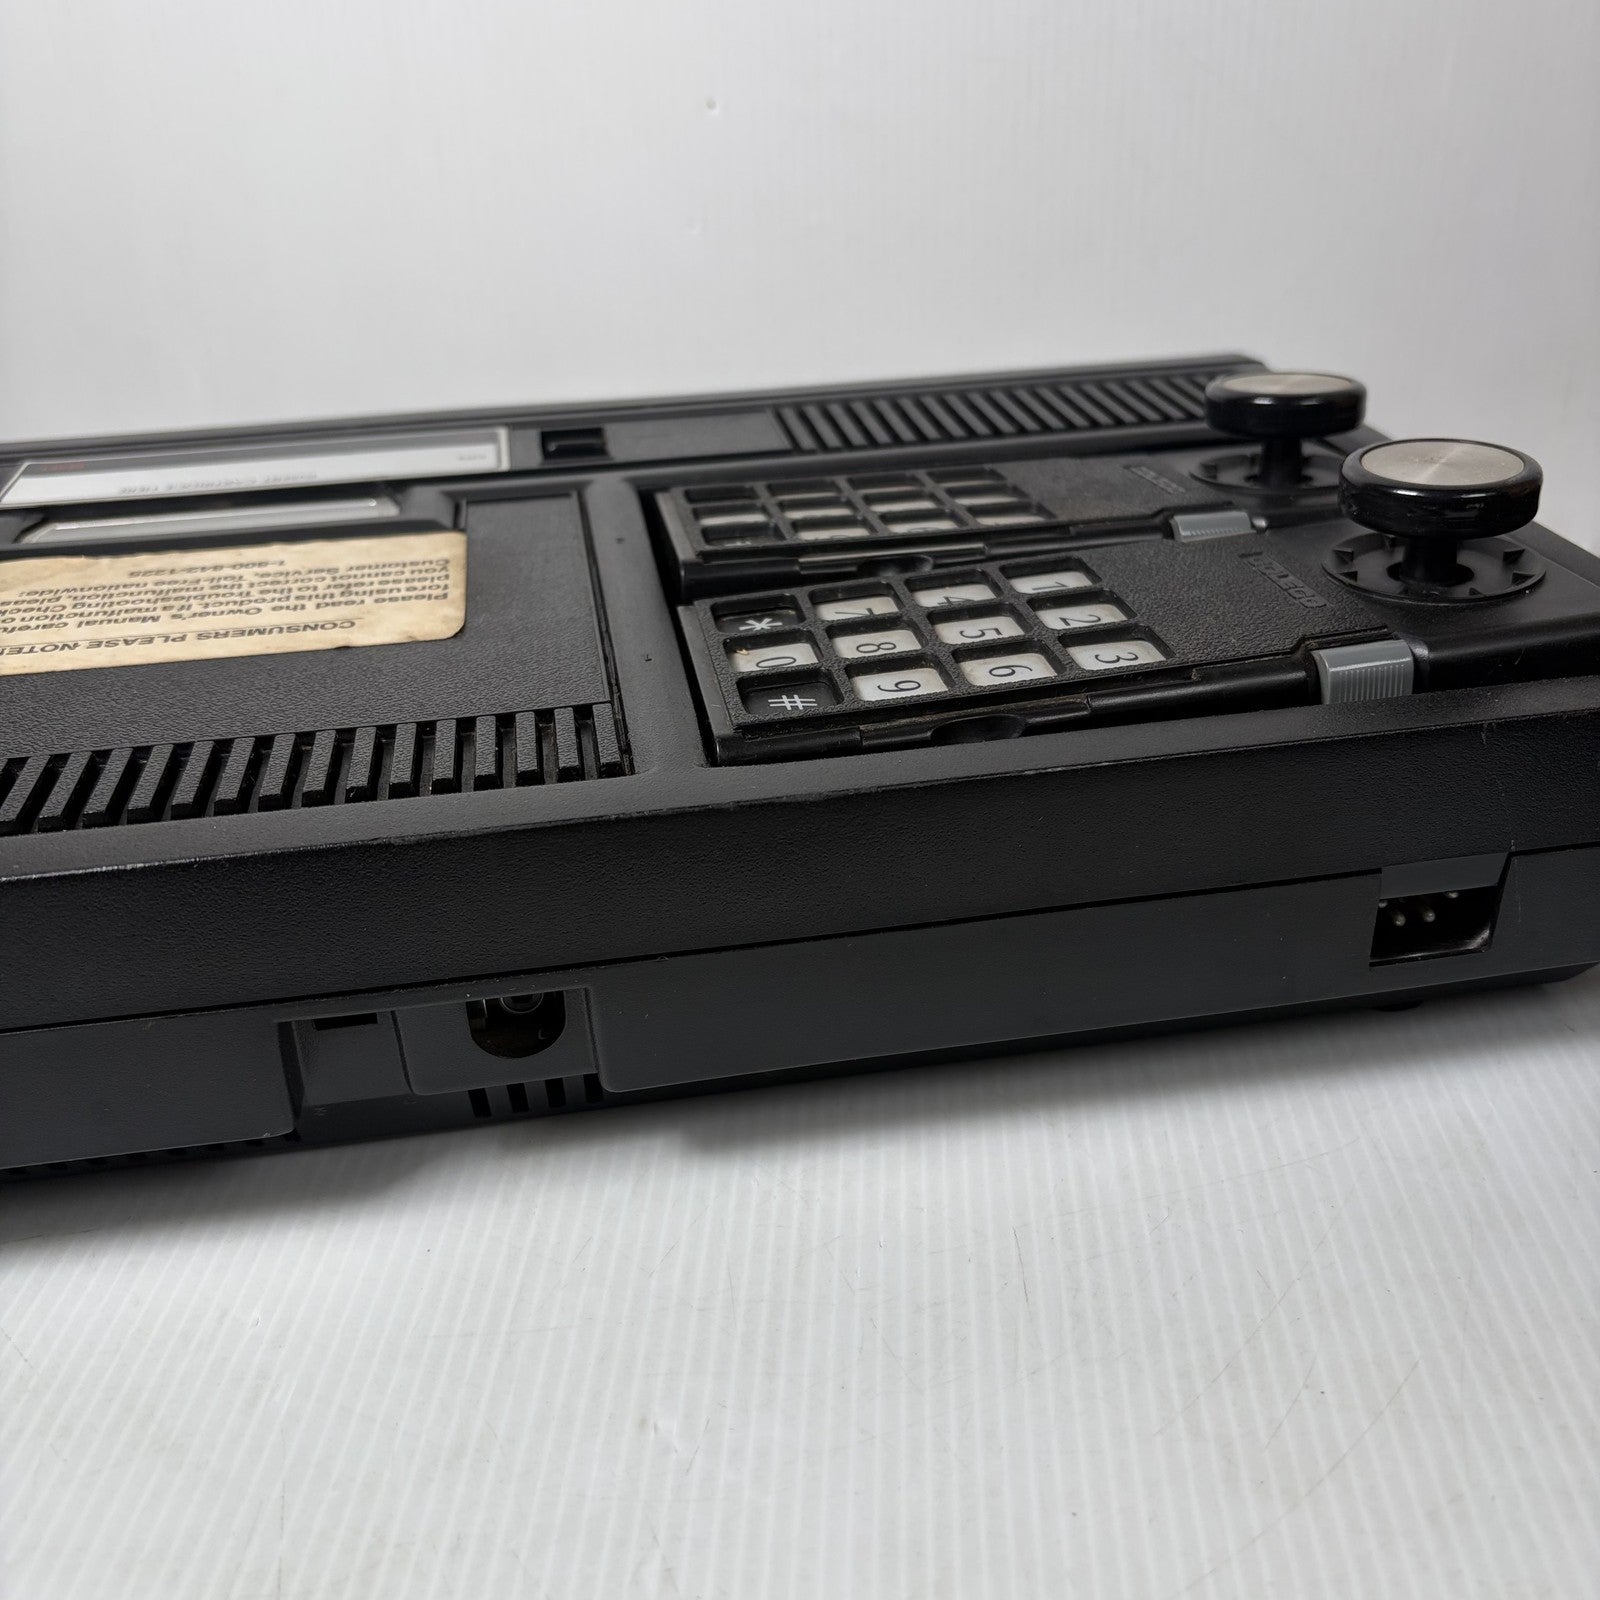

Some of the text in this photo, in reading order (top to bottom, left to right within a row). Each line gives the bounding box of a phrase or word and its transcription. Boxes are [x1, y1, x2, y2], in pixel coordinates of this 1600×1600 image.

[346, 558, 450, 571] Customer
[410, 566, 449, 575] you
[153, 575, 245, 587] Toll-Free
[248, 576, 327, 588] correct
[331, 570, 405, 581] cannot
[377, 573, 450, 586] please
[18, 582, 148, 597] nationwide:
[209, 583, 243, 591] the
[258, 587, 293, 595] the
[323, 580, 375, 590] refer
[405, 583, 449, 592] fore
[294, 592, 335, 600] this
[340, 586, 403, 598] using
[374, 592, 449, 604] Please
[71, 591, 252, 609] Troubleshooting
[202, 595, 291, 609] product.
[315, 599, 366, 610] read
[20, 606, 159, 623] malfunction
[170, 607, 263, 620] Owner's
[270, 603, 307, 613] the
[77, 615, 161, 628] Manual
[1032, 581, 1139, 664] 1 2 3
[197, 620, 357, 640] CONSUMERS
[86, 634, 188, 649] PLEASE
[834, 607, 921, 693] 7 8 9
[959, 627, 1004, 639] 5
[988, 664, 1034, 678] 6
[756, 656, 797, 669] 0
[768, 694, 818, 711] #
